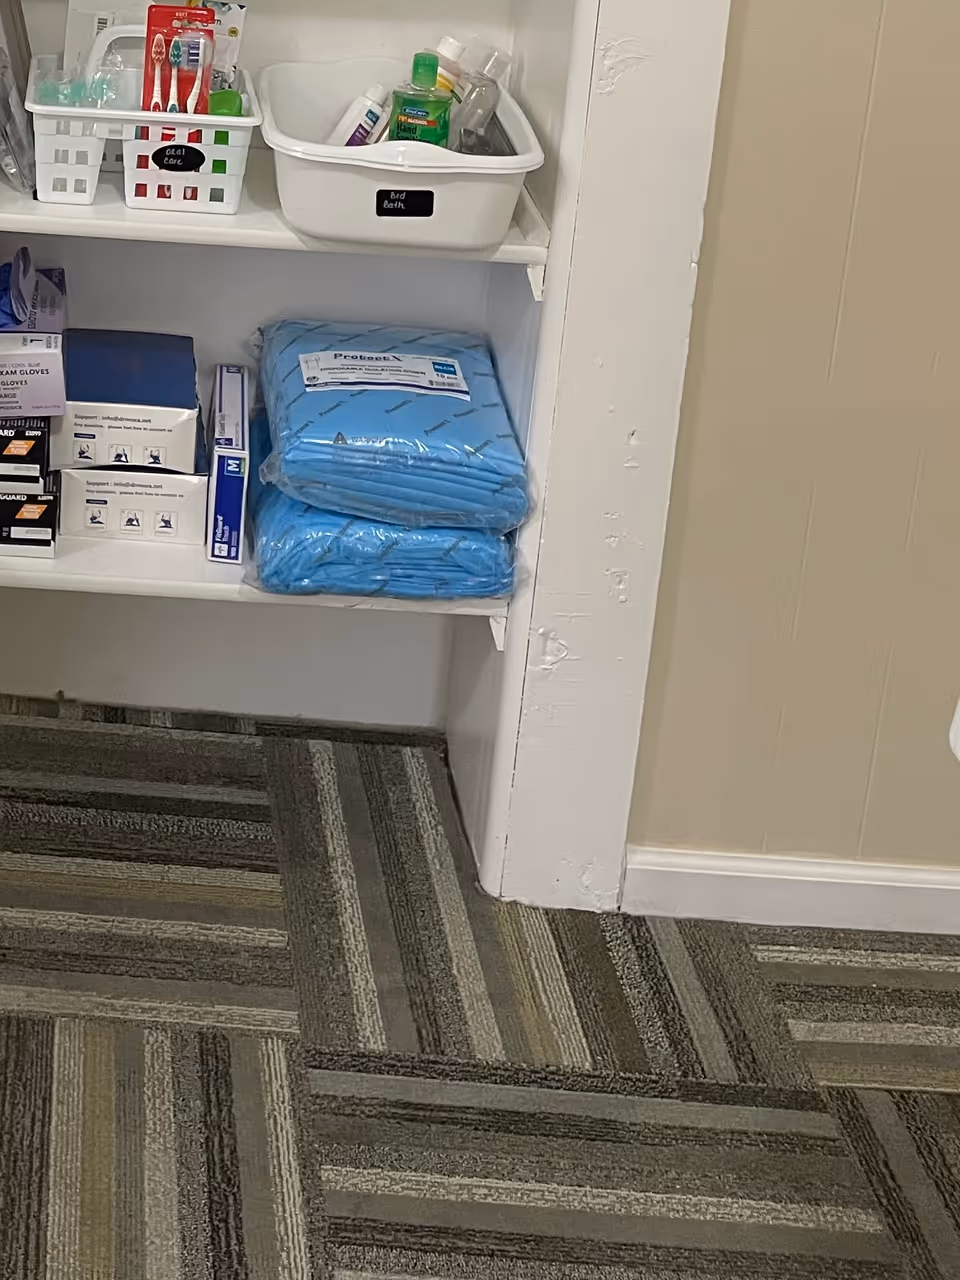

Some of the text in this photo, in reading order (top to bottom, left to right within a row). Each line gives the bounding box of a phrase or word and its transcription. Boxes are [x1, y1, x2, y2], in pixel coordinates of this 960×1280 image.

[396, 121, 417, 135] Hand
[390, 191, 406, 200] Bed
[20, 368, 49, 376] GLOVES
[227, 459, 240, 472] M
